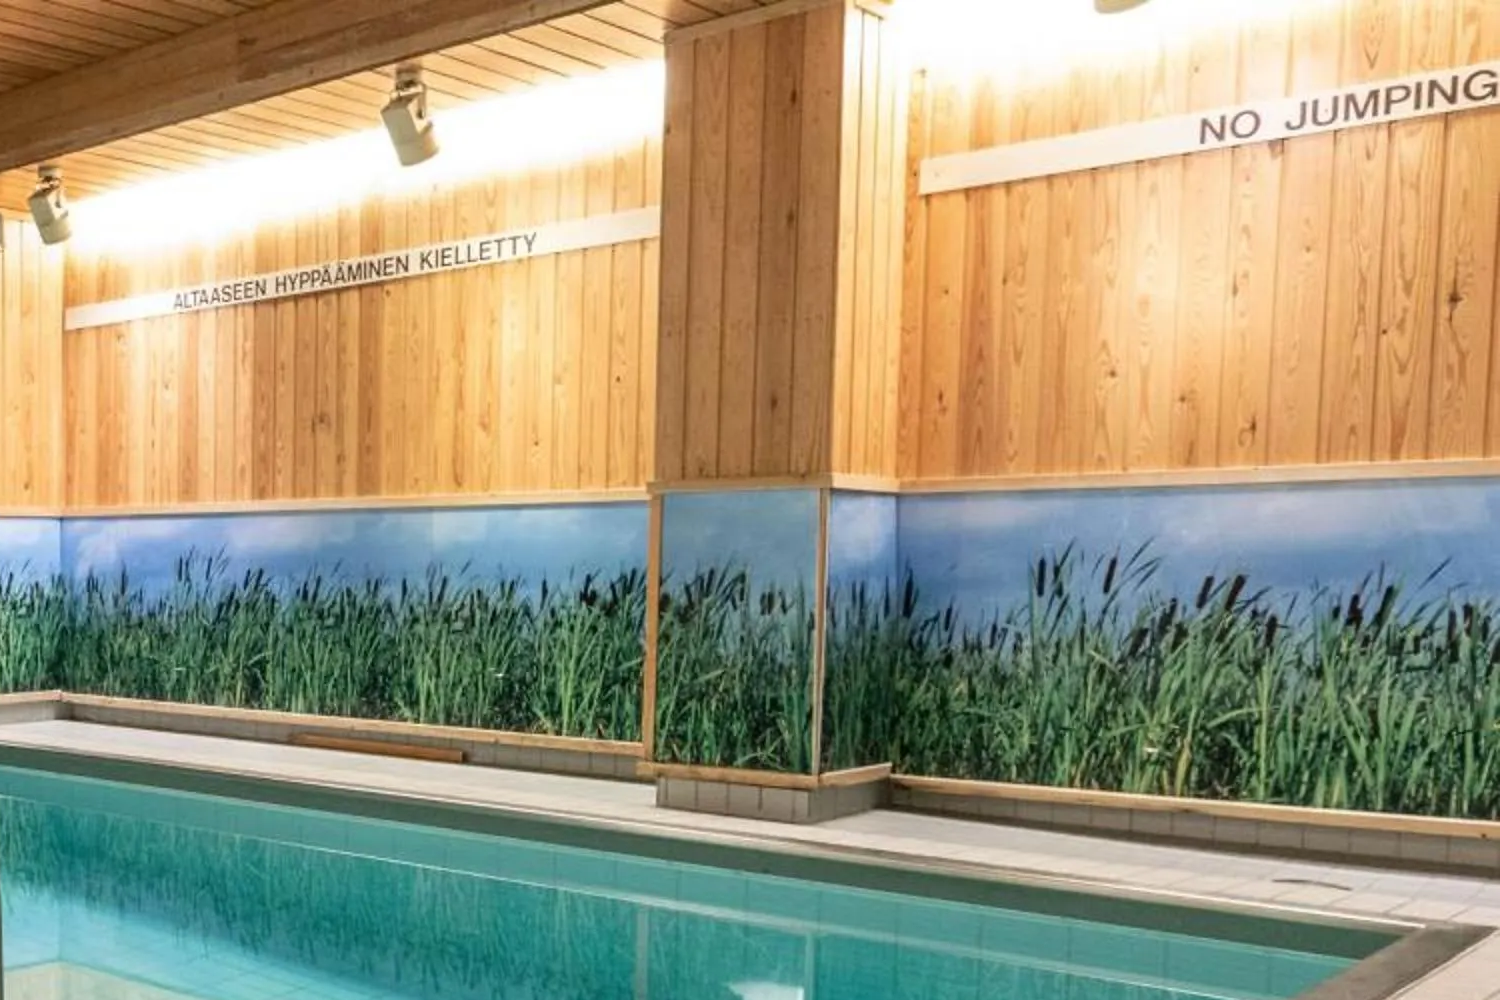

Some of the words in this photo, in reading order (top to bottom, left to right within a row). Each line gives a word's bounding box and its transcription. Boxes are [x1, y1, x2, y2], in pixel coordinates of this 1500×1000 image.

[1199, 109, 1261, 145] NO
[1284, 69, 1498, 131] JUMPING
[173, 278, 267, 311] ALTAASEEN
[275, 253, 409, 294] HYPPÄÄMINEN
[419, 231, 538, 271] KIELLETTY
